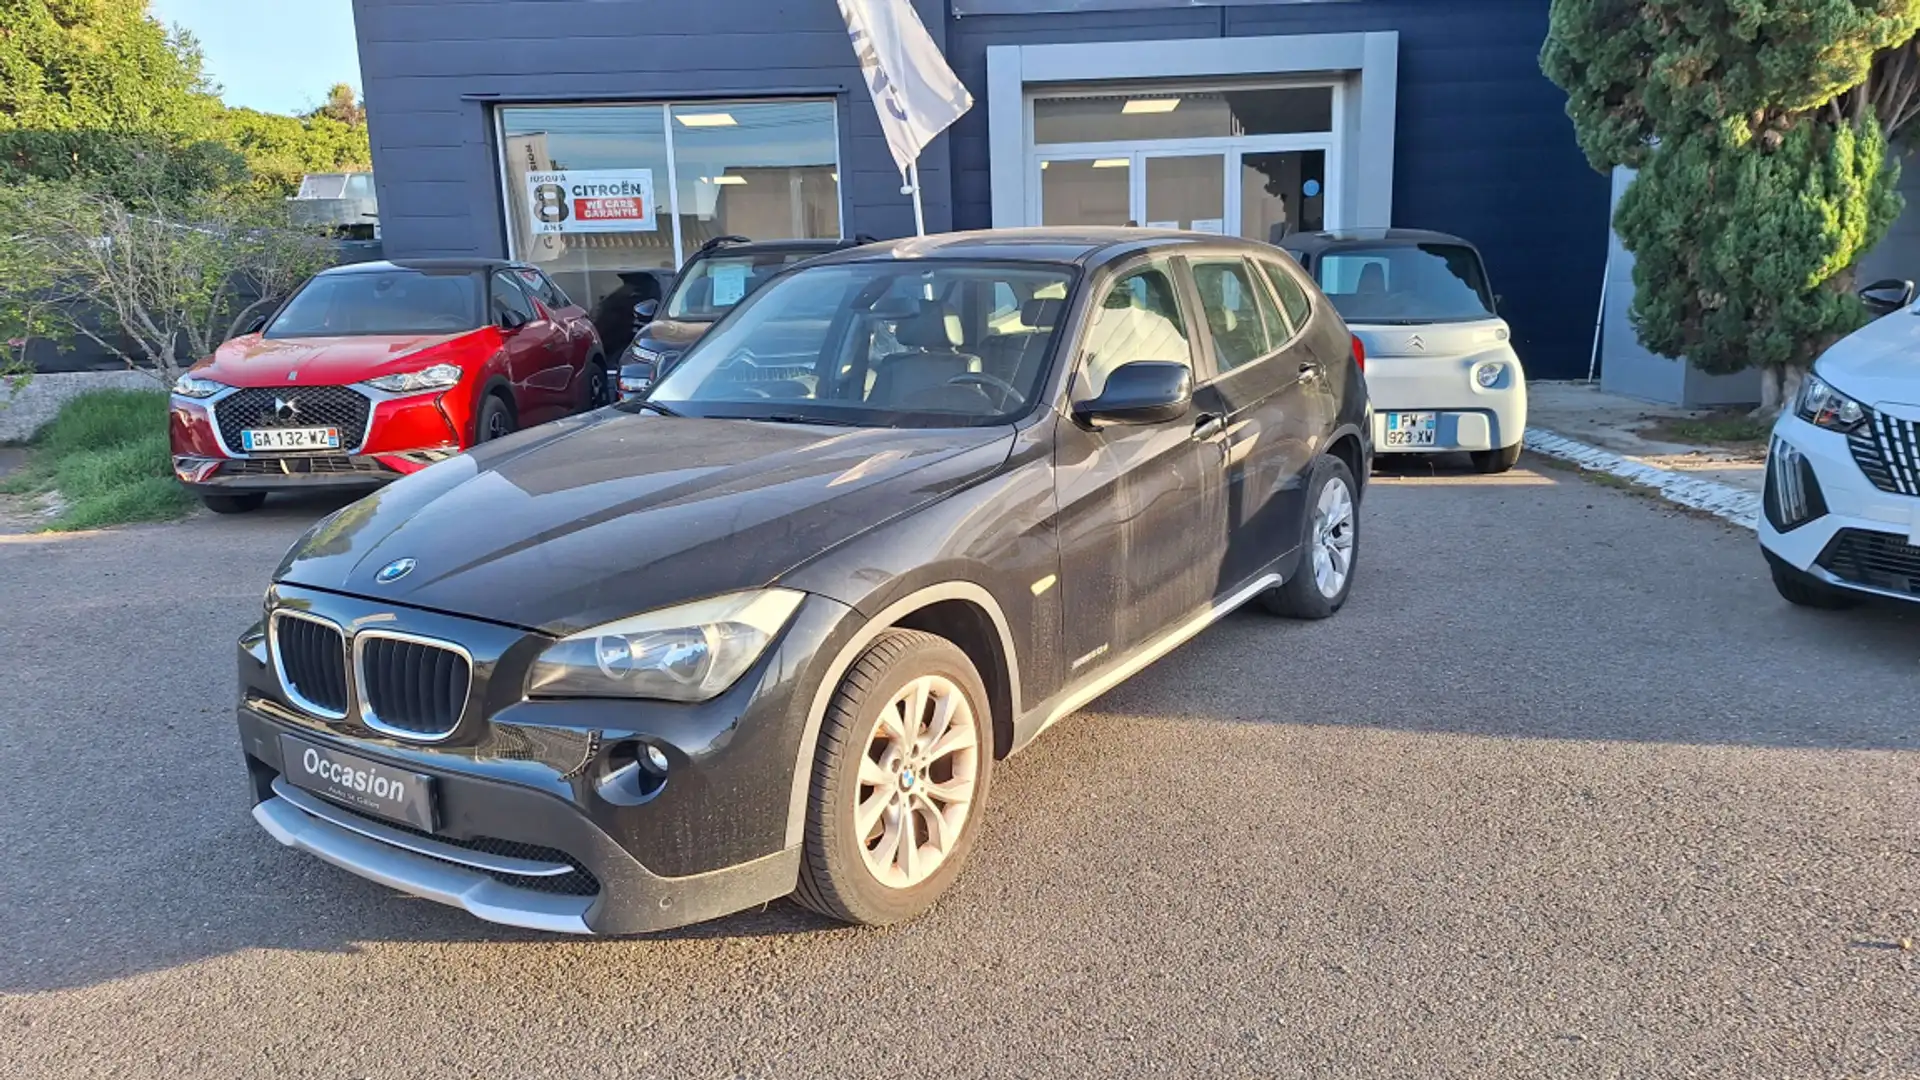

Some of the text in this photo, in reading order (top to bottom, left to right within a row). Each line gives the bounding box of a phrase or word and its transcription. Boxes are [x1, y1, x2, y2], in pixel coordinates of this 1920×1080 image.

[571, 180, 642, 197] CITROËN
[533, 183, 570, 223] 8
[543, 223, 564, 232] ANS
[303, 748, 405, 802] Occasion
